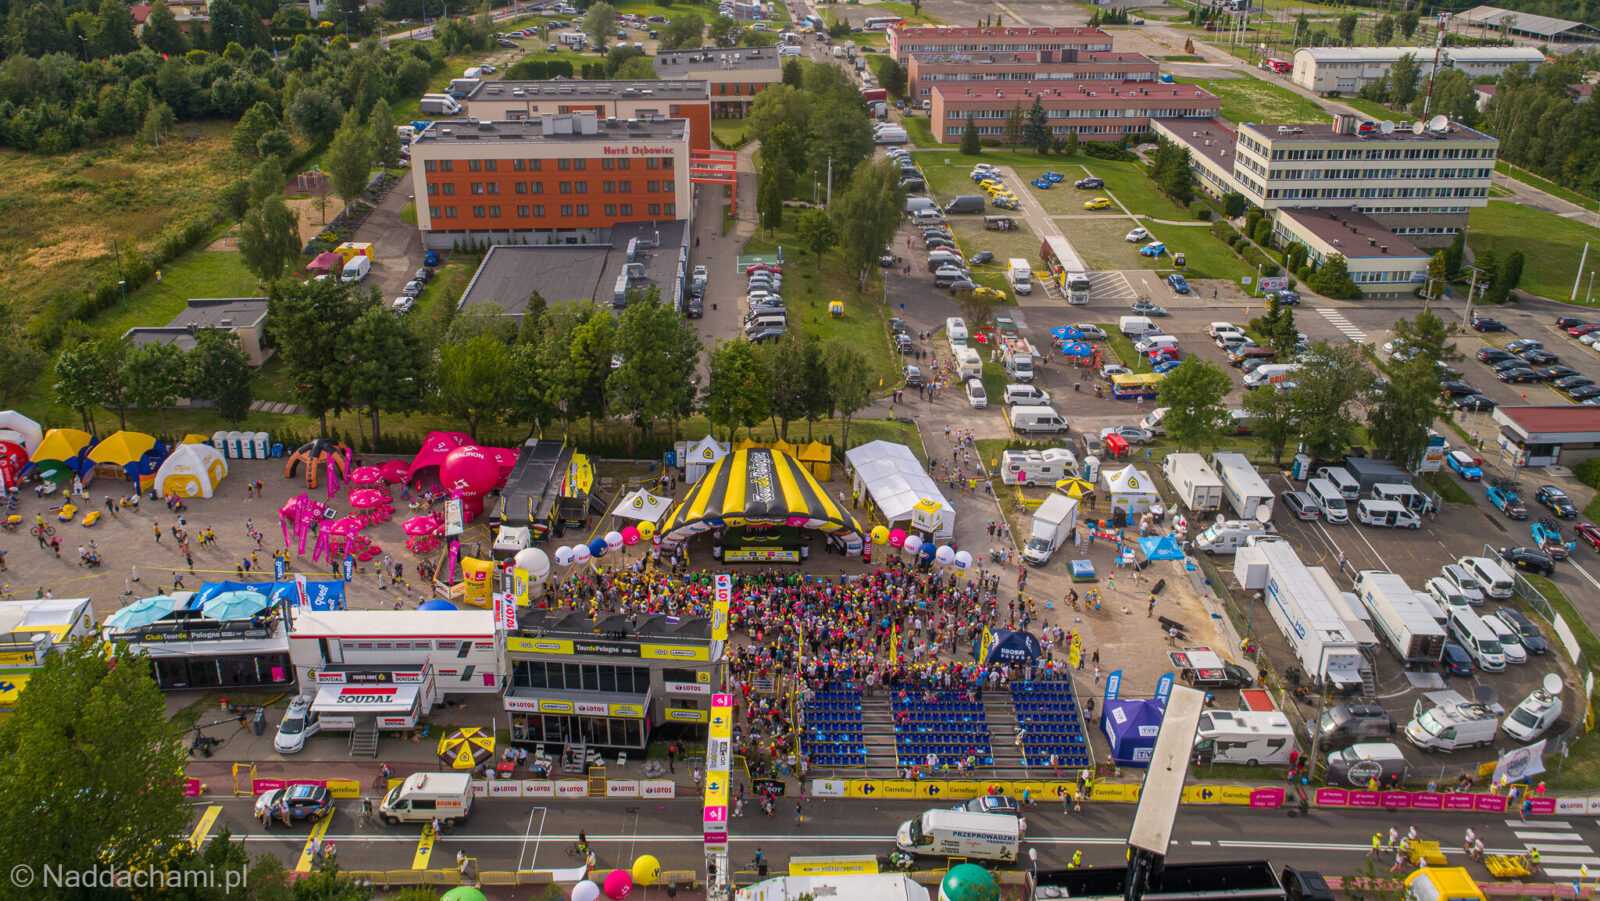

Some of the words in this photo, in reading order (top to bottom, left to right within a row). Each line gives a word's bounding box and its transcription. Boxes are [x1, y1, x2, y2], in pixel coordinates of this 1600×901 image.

[603, 145, 629, 155] Hotel
[336, 695, 393, 704] SOUDAL
[586, 705, 605, 713] LOTOS
[952, 831, 1016, 841] PRZEPROWADZKI
